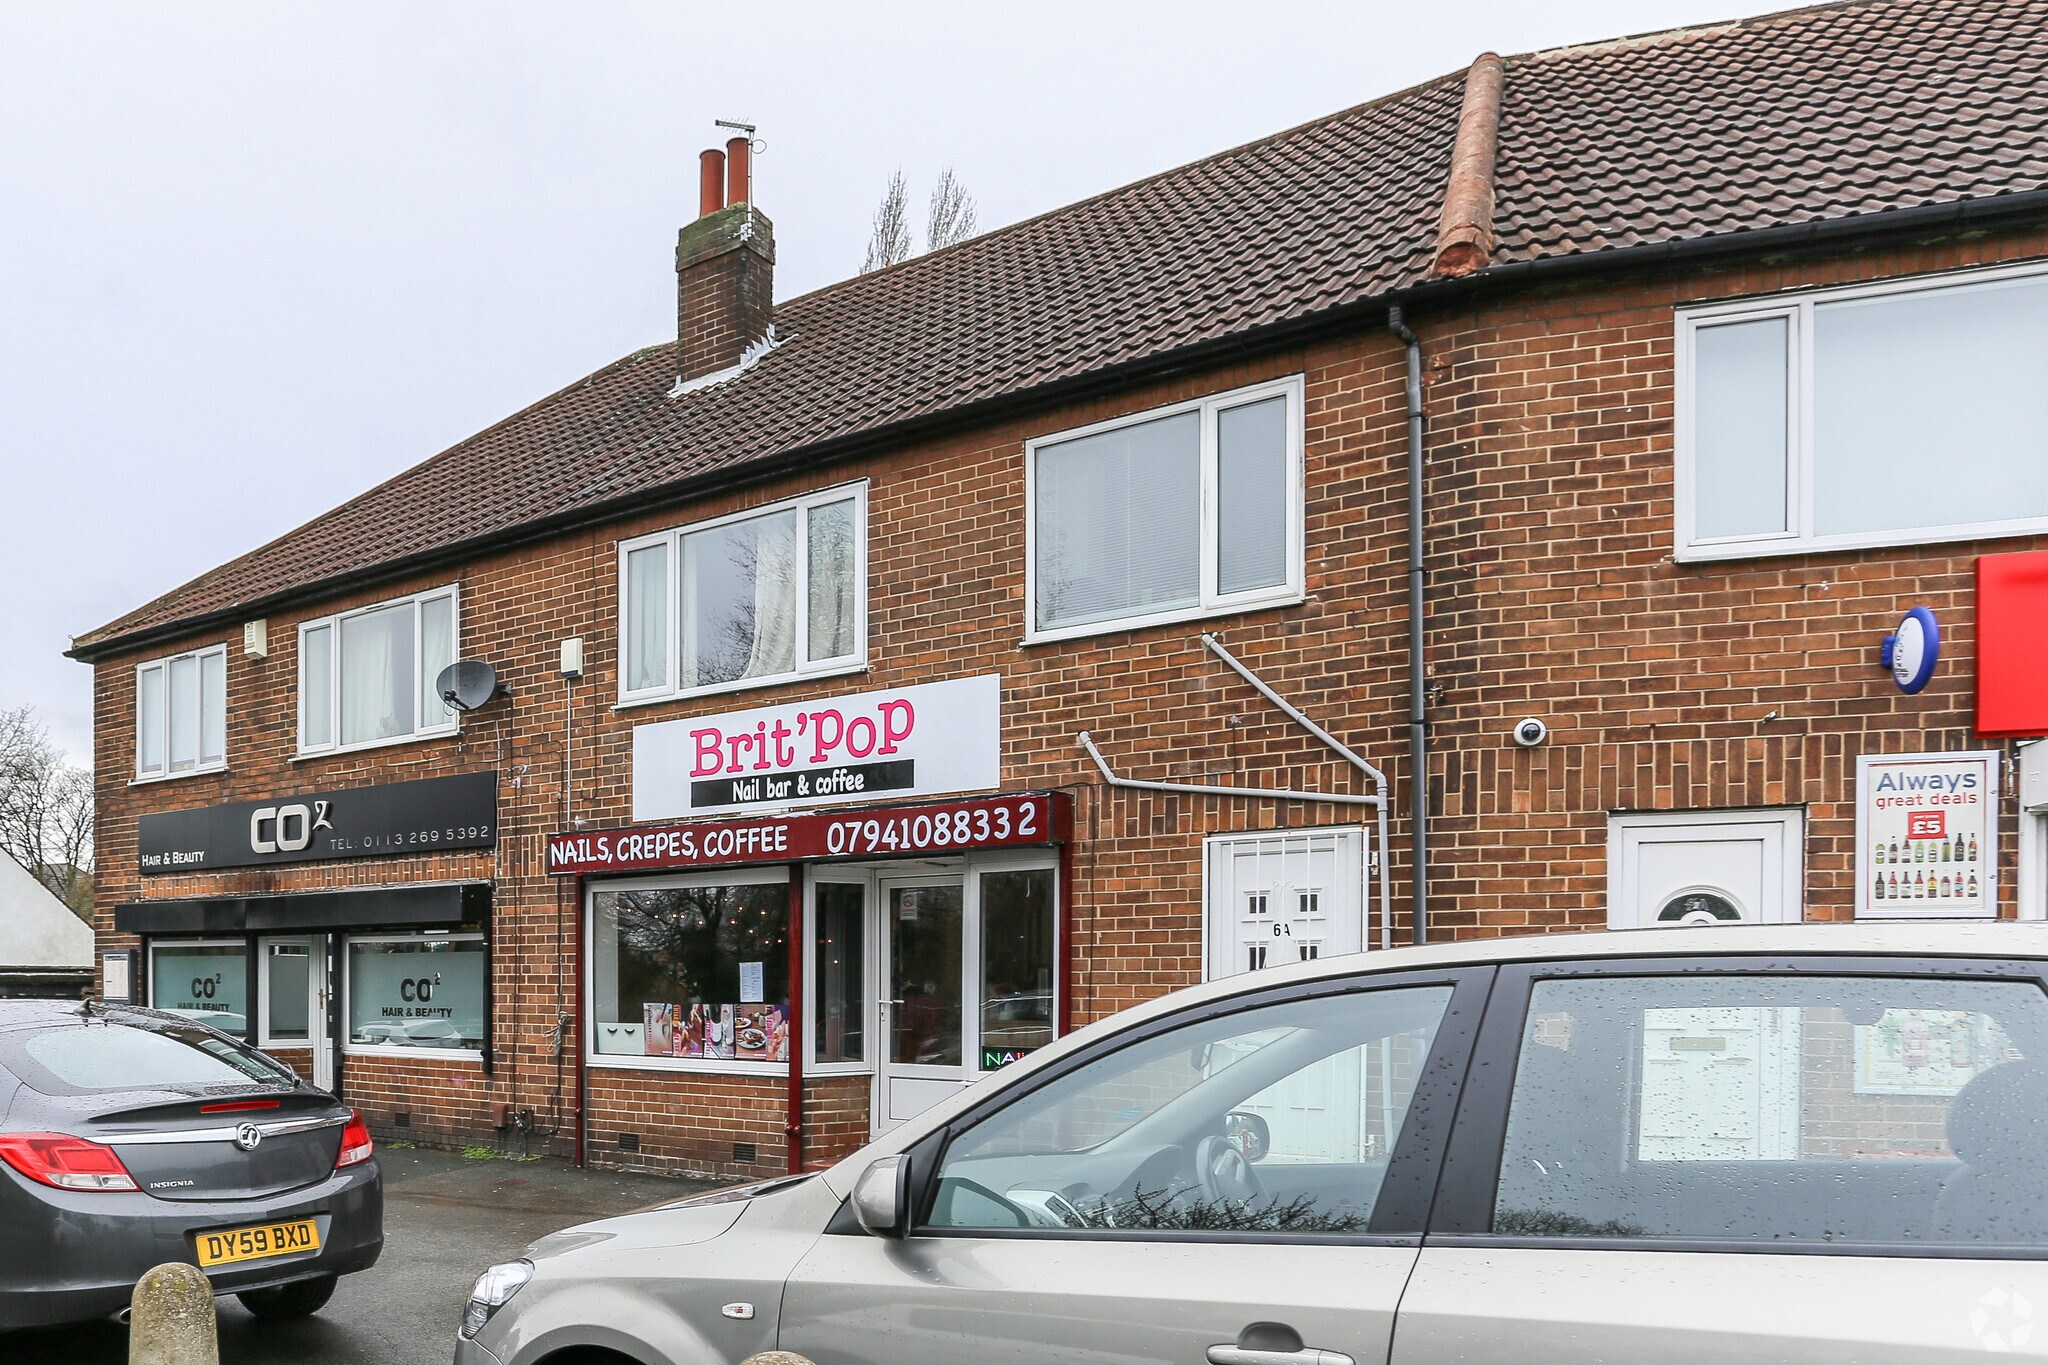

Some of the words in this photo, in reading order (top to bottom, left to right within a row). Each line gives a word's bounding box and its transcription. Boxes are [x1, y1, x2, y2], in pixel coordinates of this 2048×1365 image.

[732, 779, 760, 802] Nail
[766, 777, 792, 799] bar
[797, 774, 810, 795] &
[815, 768, 865, 795] coffee
[1875, 771, 1977, 793] Always
[1876, 794, 1923, 810] great
[1930, 791, 1978, 806] deals
[1912, 820, 1942, 835] £5
[330, 838, 358, 851] TEL:
[363, 833, 403, 848] 0113
[409, 829, 439, 844] 269
[446, 825, 489, 841] 5392
[550, 837, 613, 867] NAILS,
[616, 831, 699, 862] CREPES,
[703, 825, 789, 858] COFFEE
[163, 852, 171, 865] &
[177, 1002, 194, 1010] HAIR
[202, 1003, 230, 1012] BEAUTY
[382, 1007, 404, 1017] HAIR
[405, 1007, 413, 1017] &
[149, 1179, 195, 1189] INSIGNIA
[206, 1230, 268, 1260] DY59
[272, 1224, 312, 1250] BXD
